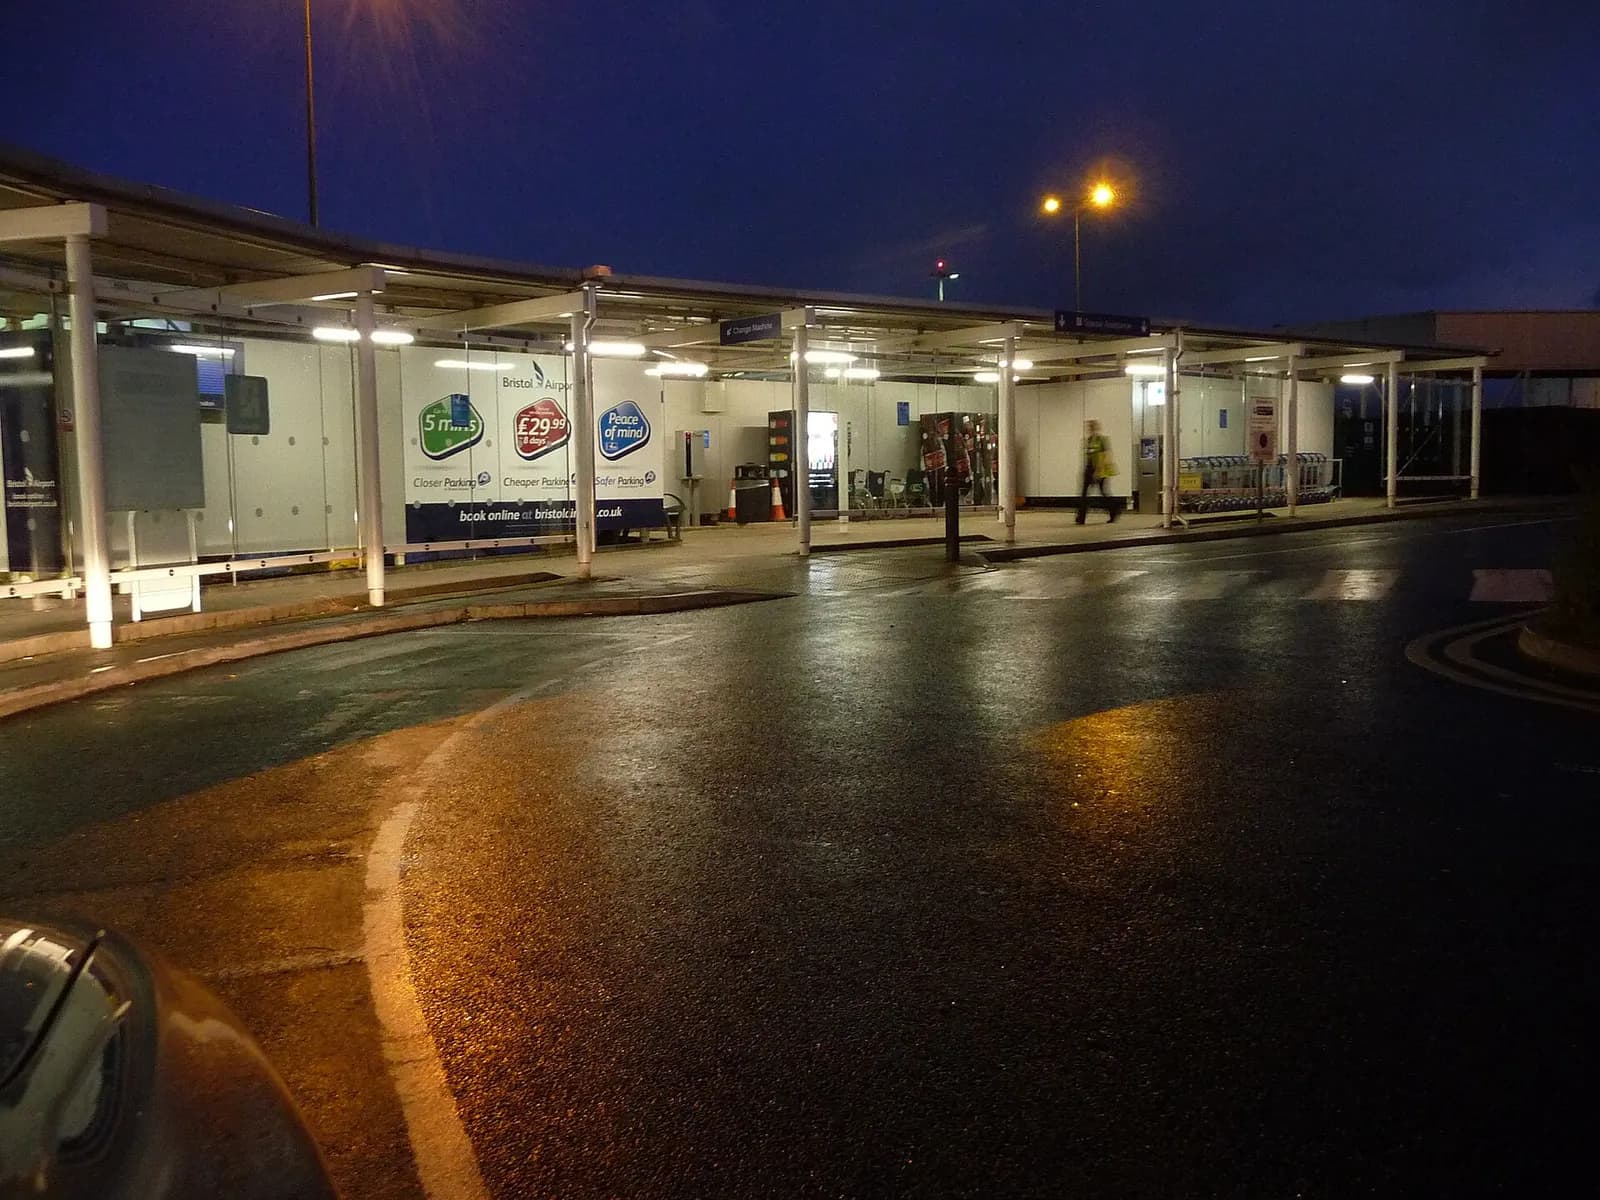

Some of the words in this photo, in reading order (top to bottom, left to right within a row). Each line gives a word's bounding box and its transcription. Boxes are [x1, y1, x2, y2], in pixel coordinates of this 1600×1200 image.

[502, 377, 534, 389] Bristol
[544, 379, 574, 393] Airpor
[423, 414, 436, 431] 5
[608, 412, 639, 425] Peace
[517, 416, 566, 436] £29.99
[604, 425, 618, 441] of
[617, 426, 644, 438] mind
[523, 436, 529, 445] 8
[413, 477, 442, 488] Closer
[443, 477, 477, 489] Parking
[503, 477, 540, 489] Cheaper
[541, 477, 569, 489] Parking
[596, 475, 616, 487] Safer
[617, 476, 644, 488] Parking
[459, 509, 487, 522] book
[487, 508, 520, 521] online
[521, 511, 534, 521] at
